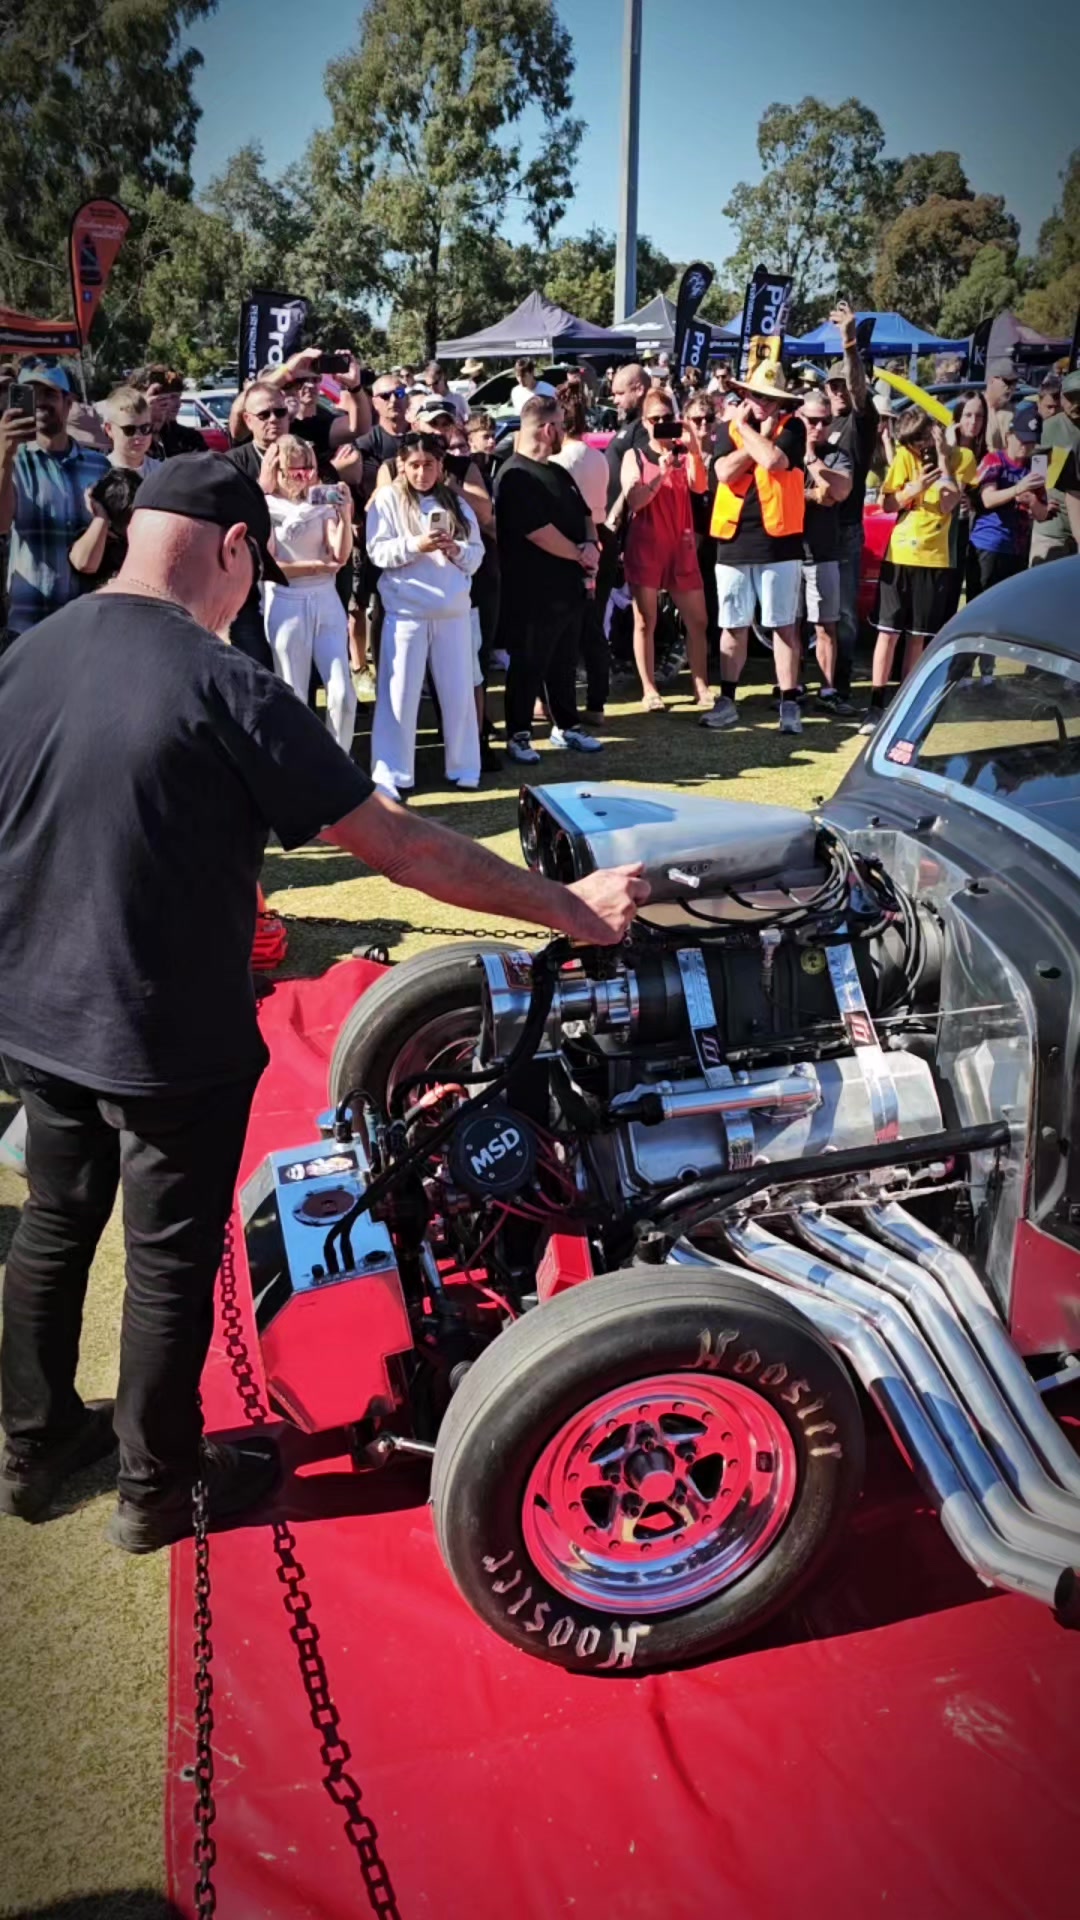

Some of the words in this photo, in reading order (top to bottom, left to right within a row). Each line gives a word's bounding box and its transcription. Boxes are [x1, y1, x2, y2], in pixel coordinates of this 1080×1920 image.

[761, 285, 784, 334] Pro
[268, 307, 292, 367] Pro
[690, 331, 706, 366] Pro
[470, 1127, 520, 1175] MSD
